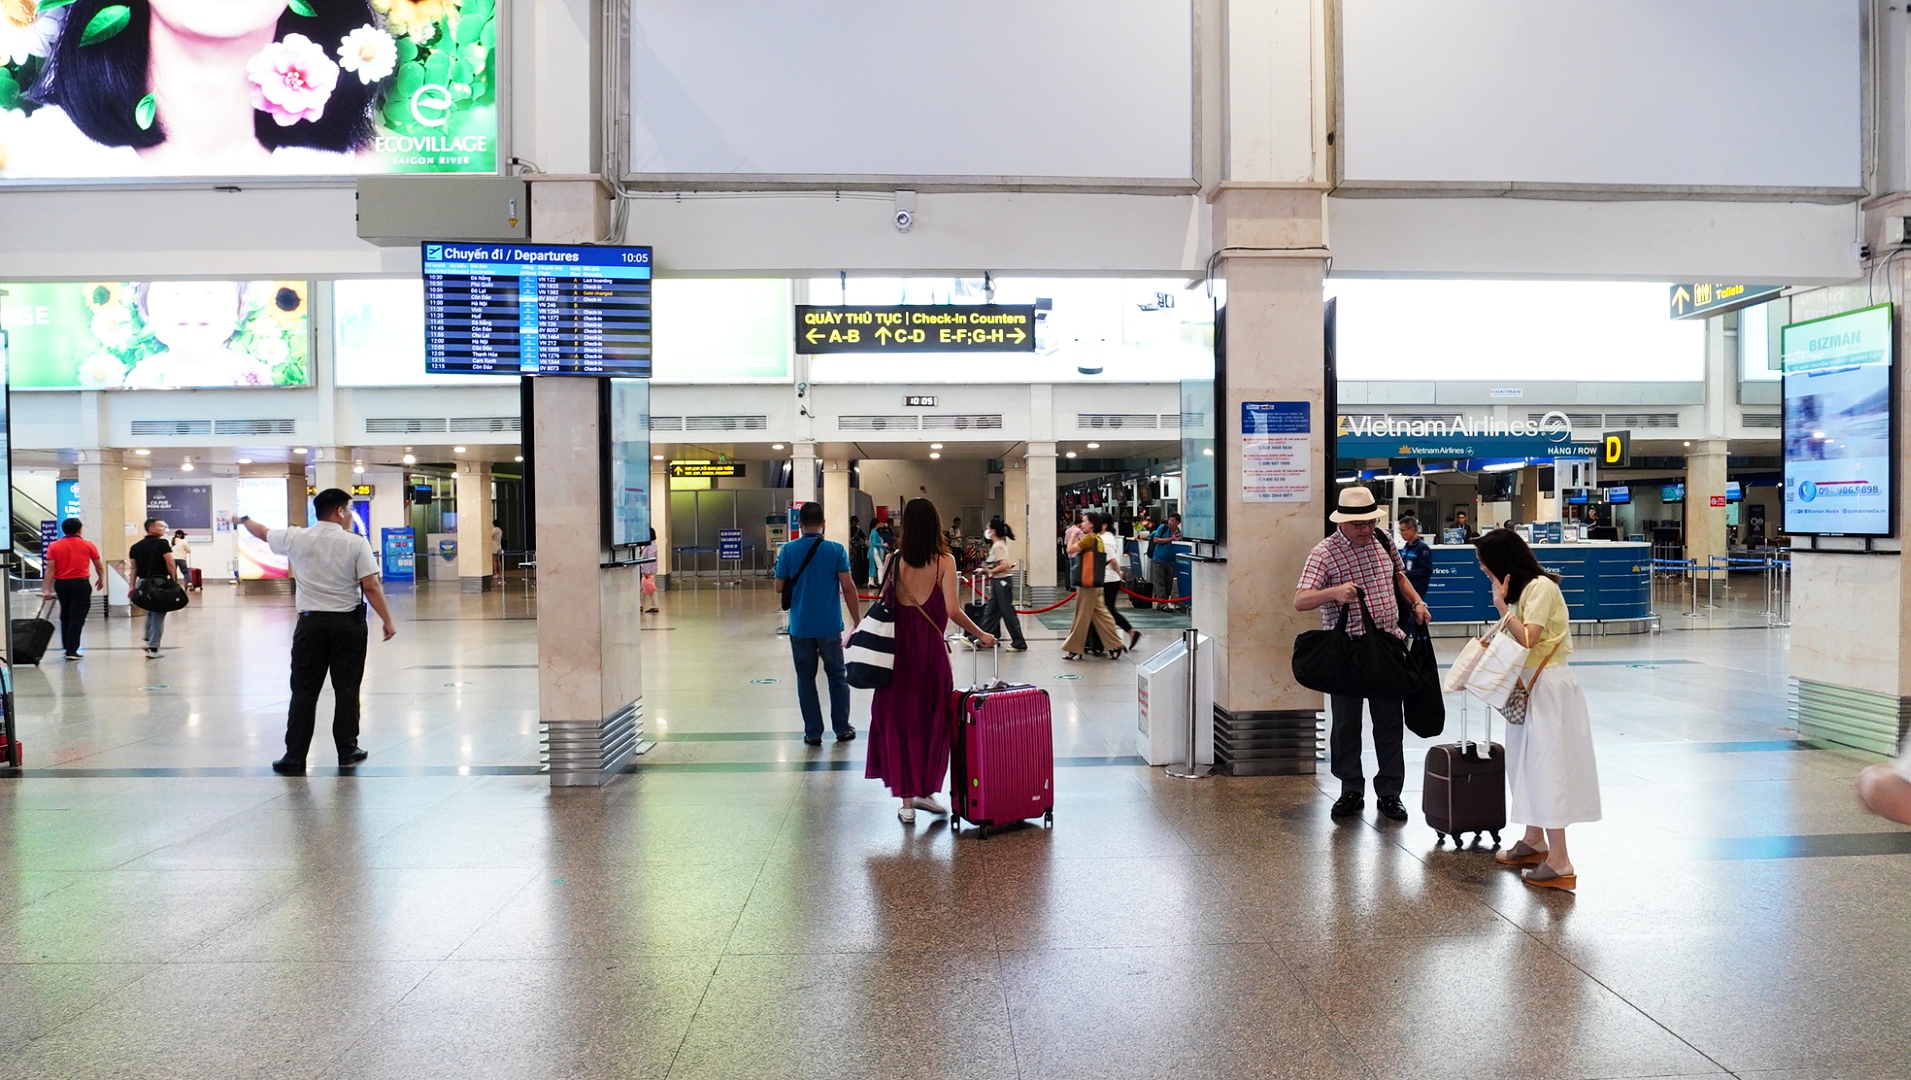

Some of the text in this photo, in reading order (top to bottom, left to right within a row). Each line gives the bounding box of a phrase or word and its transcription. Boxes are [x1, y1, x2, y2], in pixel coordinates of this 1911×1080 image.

[375, 136, 487, 152] ECOVILLAGE
[393, 156, 470, 165] SAIGON RIVER
[444, 248, 489, 262] Chuyến
[491, 249, 503, 260] đi
[514, 250, 580, 264] Departures
[621, 252, 649, 264] 10:05
[1715, 285, 1744, 300] Toilets
[845, 311, 873, 325] THỦ
[875, 313, 903, 326] TỤC
[912, 313, 967, 325] Check-in
[969, 313, 1026, 325] Counters
[828, 329, 1004, 345] A-B C-D E-F;G-H
[1809, 331, 1861, 352] BIZMAN
[1348, 414, 1537, 437] Vietnam Airlines
[1411, 446, 1464, 455] Vietnam Airlines
[1547, 446, 1570, 455] HÀNG
[1577, 447, 1597, 455] ROW
[1606, 436, 1621, 463] D
